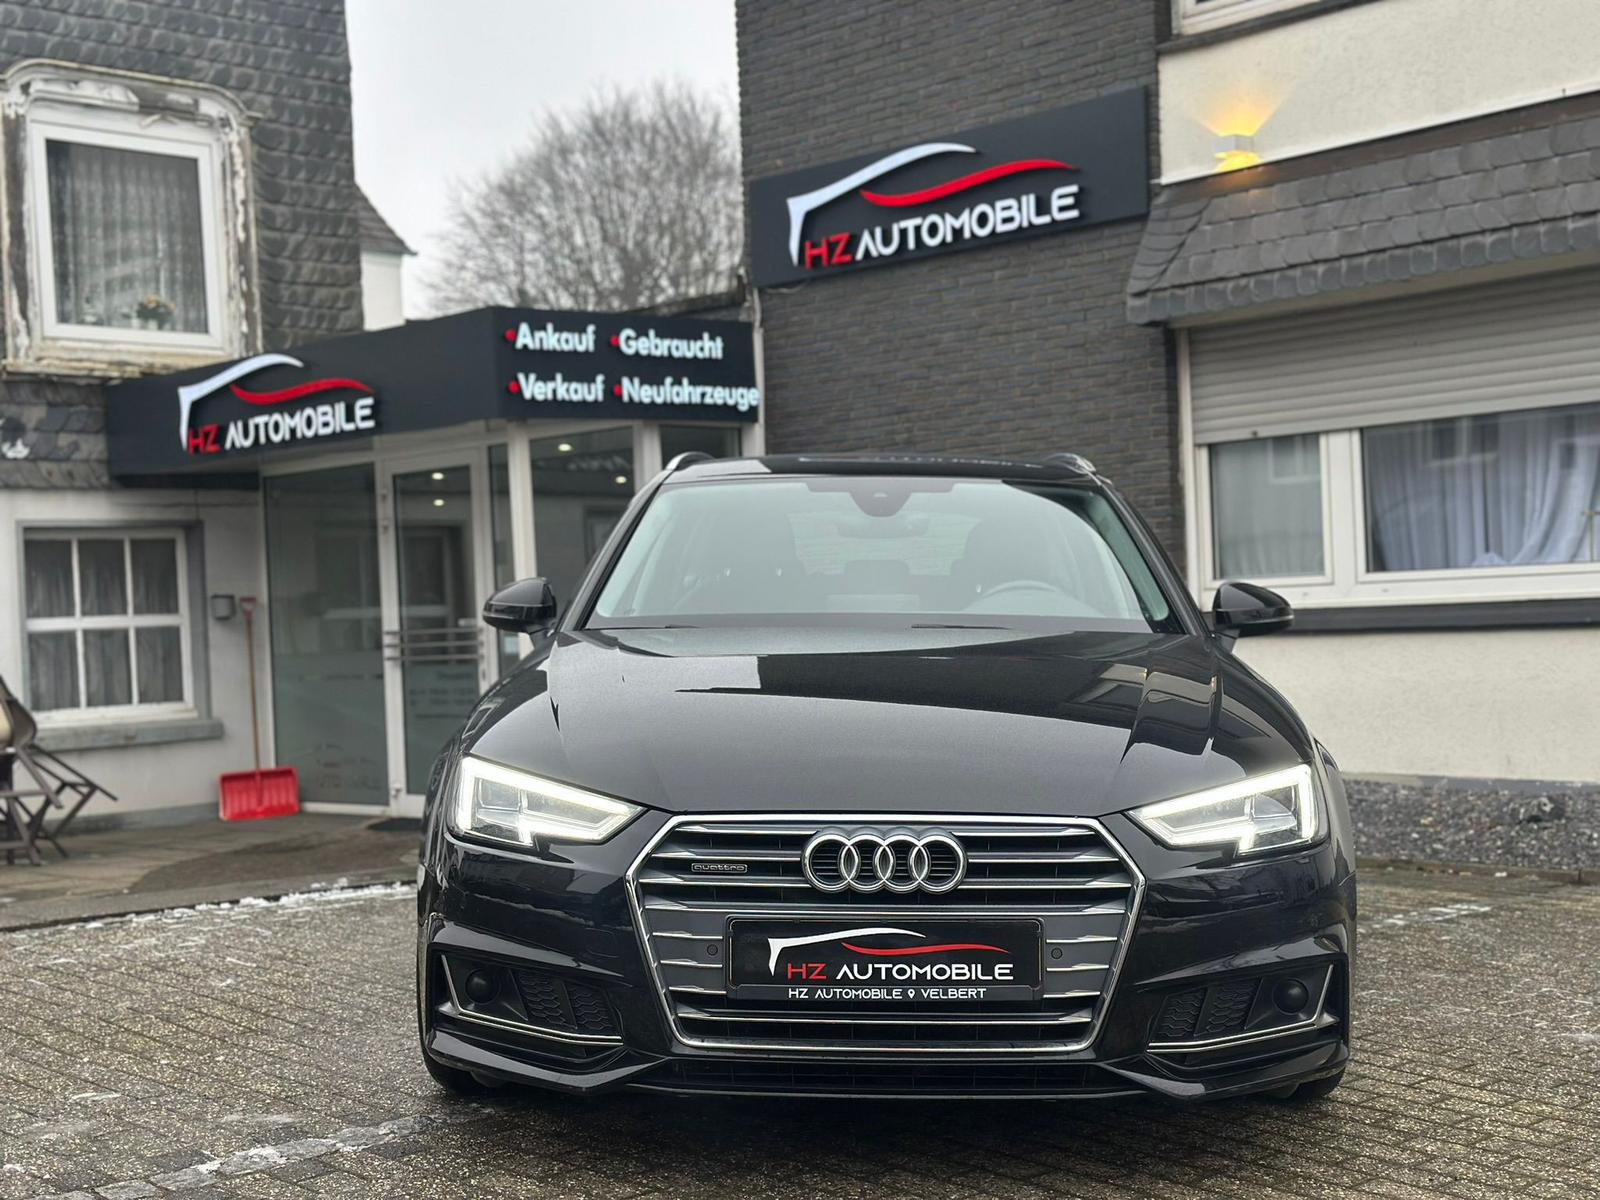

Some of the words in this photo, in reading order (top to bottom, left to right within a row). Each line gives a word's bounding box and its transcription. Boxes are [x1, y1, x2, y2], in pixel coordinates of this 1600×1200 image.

[804, 232, 853, 270] HZ
[854, 184, 1080, 261] AUTOMOBILE
[515, 322, 596, 352] Ankauf
[618, 328, 724, 359] Gebraucht
[517, 372, 605, 402] Verkauf
[621, 376, 760, 411] Neufahrzeuge
[187, 424, 221, 455] HZ
[224, 396, 376, 450] AUTOMOBILE
[787, 962, 827, 980] HZ
[836, 963, 1014, 980] AUTOMOBILE
[788, 988, 809, 999] HZ
[815, 988, 903, 999] AUTOMOBILE
[921, 988, 987, 999] VELBERT
